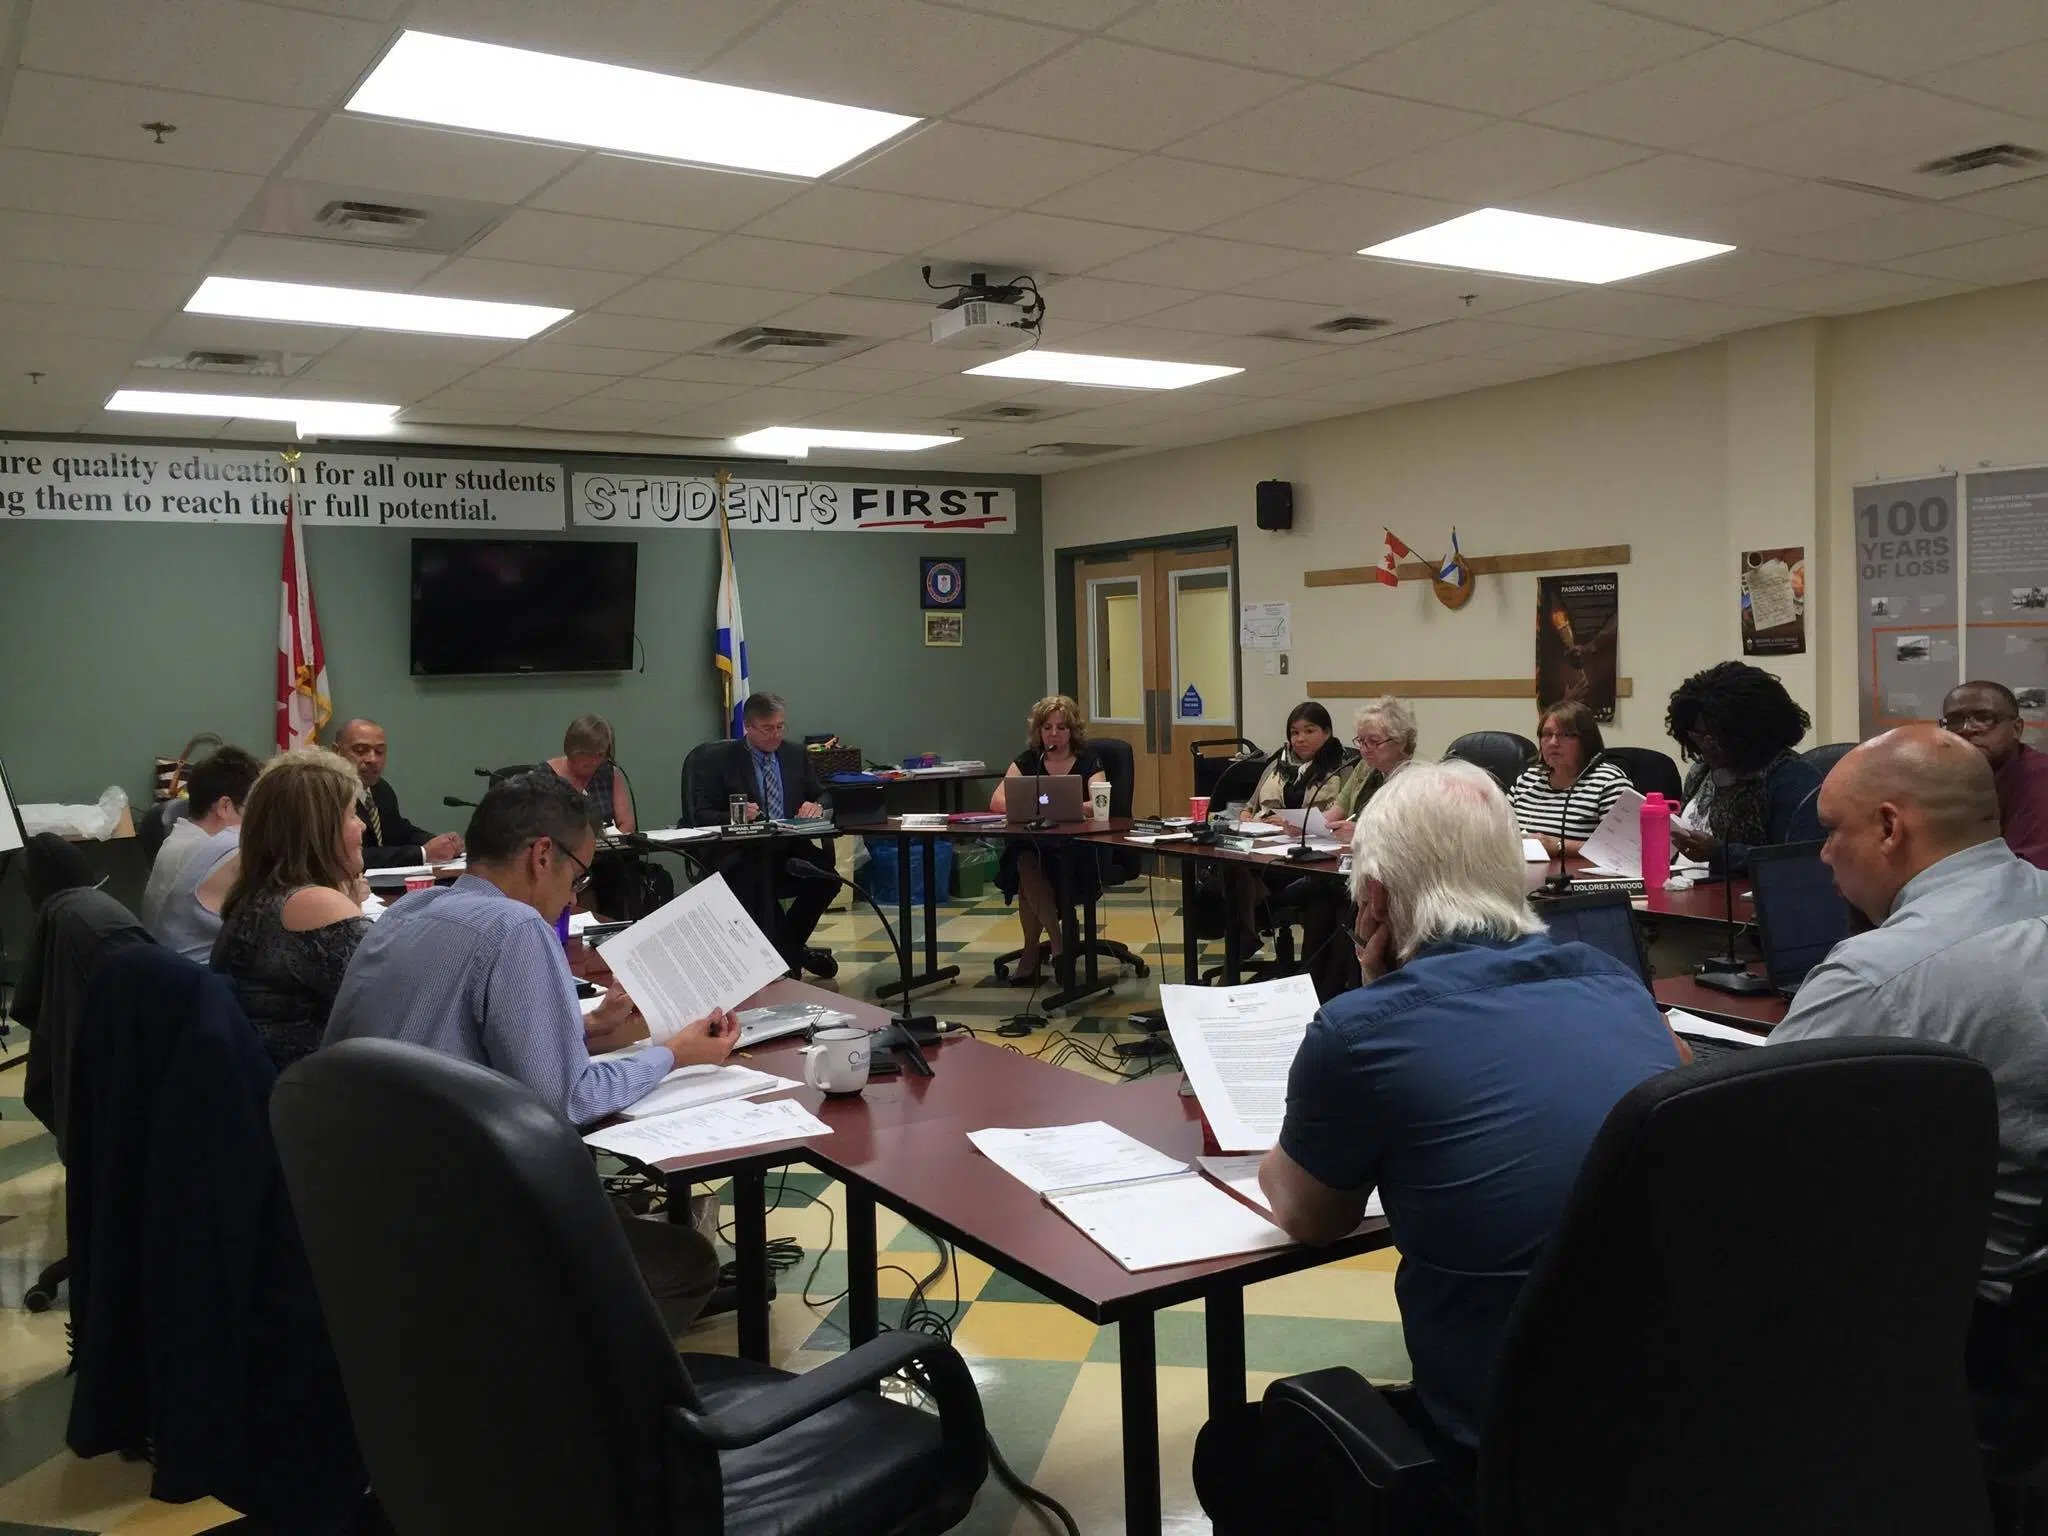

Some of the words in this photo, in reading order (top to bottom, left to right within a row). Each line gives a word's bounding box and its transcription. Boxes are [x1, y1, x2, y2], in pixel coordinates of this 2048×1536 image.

[52, 452, 158, 485] quality
[168, 456, 306, 484] education
[315, 460, 355, 486] for
[363, 463, 395, 487] all
[403, 470, 448, 489] our
[455, 468, 556, 492] students
[0, 490, 26, 516] g
[35, 484, 113, 512] them
[124, 490, 151, 513] to
[161, 490, 241, 515] reach
[325, 493, 369, 518] full
[378, 497, 498, 525] potential.
[584, 476, 839, 525] STUDENTS
[852, 487, 999, 520] FIRST
[1860, 496, 1949, 539] 100
[1860, 535, 1950, 561] YEARS
[1861, 563, 1889, 580] OF
[1895, 558, 1951, 578] LOSS
[1561, 584, 1586, 593] PASSING
[1594, 583, 1615, 592] TORCH
[1573, 883, 1609, 892] DOLORES
[1610, 881, 1643, 890] ATWOOD
